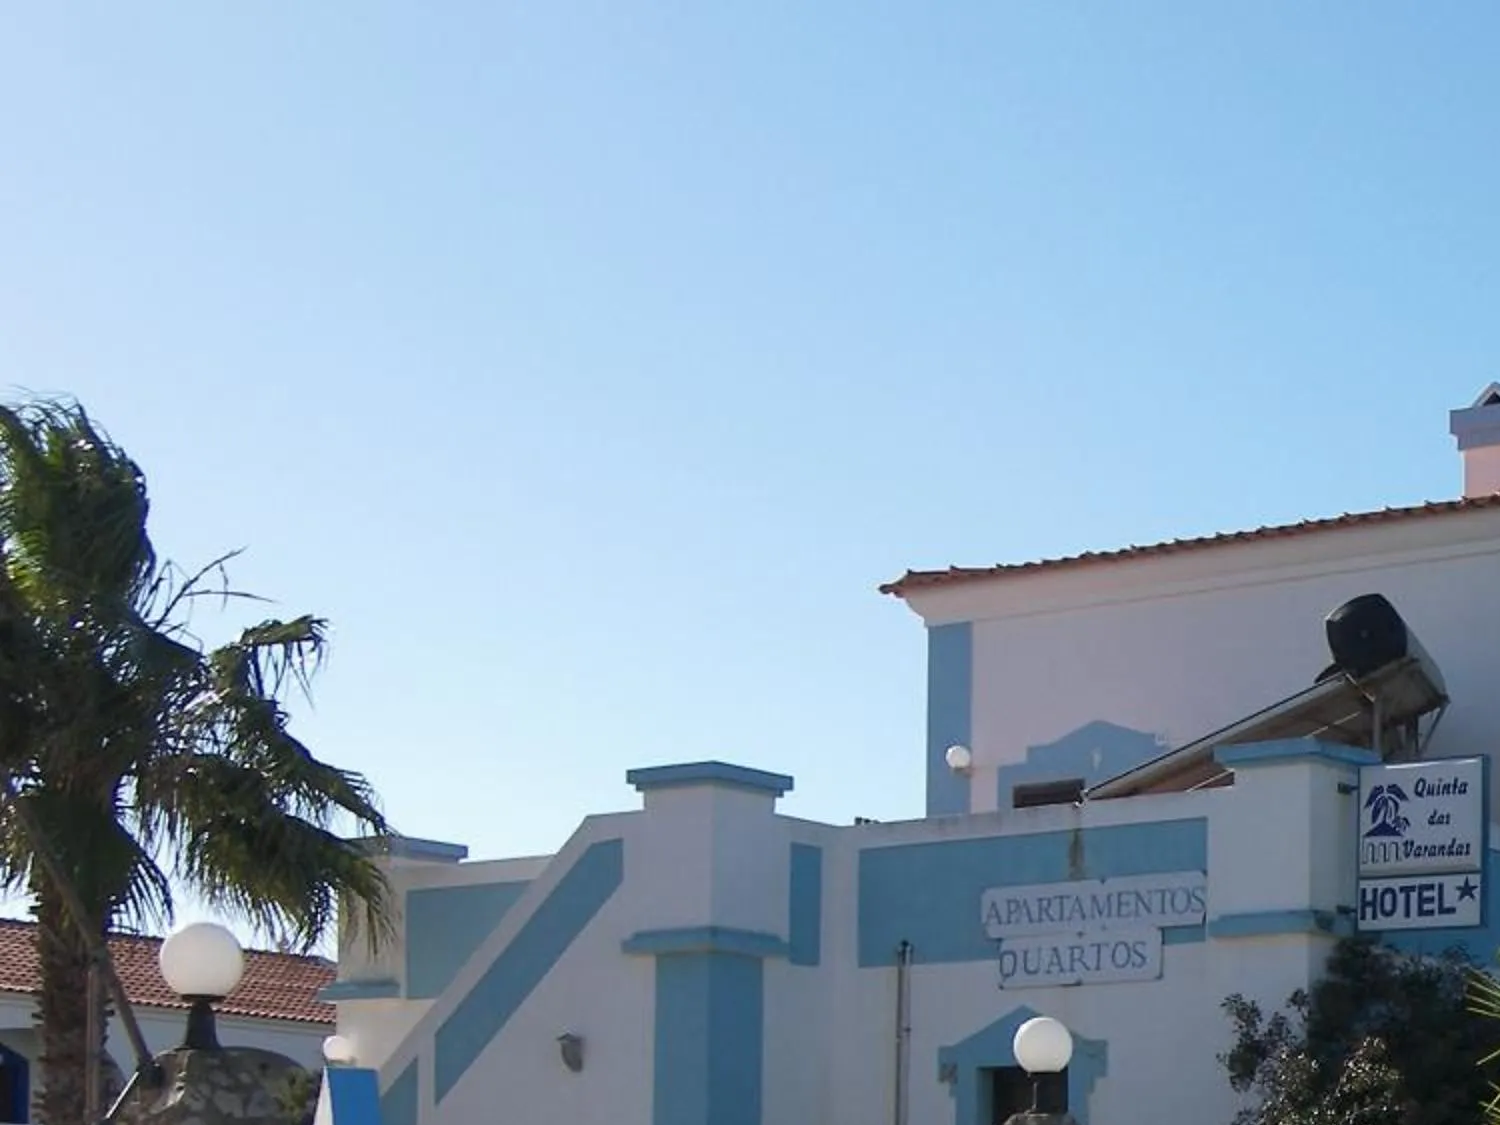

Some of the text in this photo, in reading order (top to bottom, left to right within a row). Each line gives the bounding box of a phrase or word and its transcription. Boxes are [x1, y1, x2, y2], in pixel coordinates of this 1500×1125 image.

[1414, 777, 1468, 798] Quinta
[1427, 810, 1450, 826] das
[1402, 838, 1471, 859] Varandas
[985, 886, 1207, 925] APARTAMENTOS
[1360, 883, 1456, 920] HOTEL
[1000, 941, 1147, 981] QUARTOS
